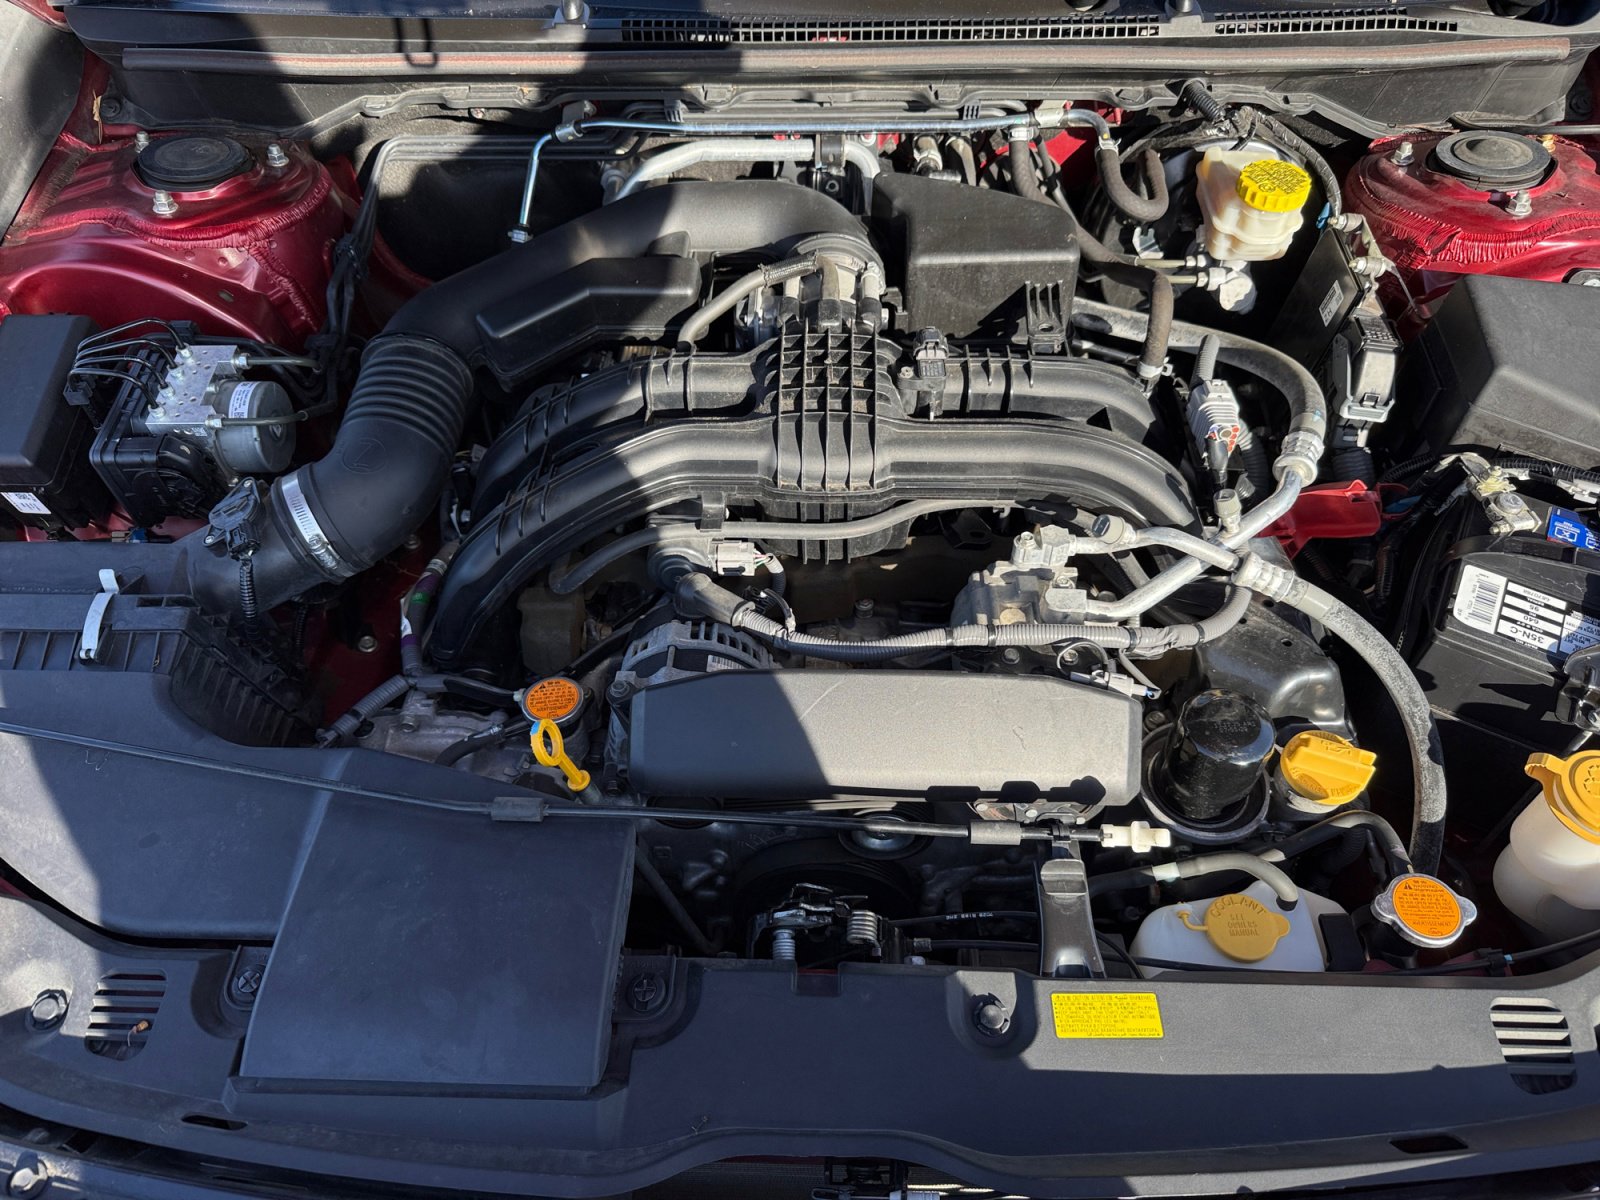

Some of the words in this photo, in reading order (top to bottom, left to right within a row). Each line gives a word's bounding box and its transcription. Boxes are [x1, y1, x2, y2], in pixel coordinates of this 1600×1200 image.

[1529, 604, 1539, 612] 95
[1523, 615, 1539, 625] 640
[1510, 626, 1545, 644] 35N-C
[1210, 896, 1267, 919] COOLANT
[1230, 912, 1244, 921] SEE
[1229, 928, 1259, 937] MANUAL
